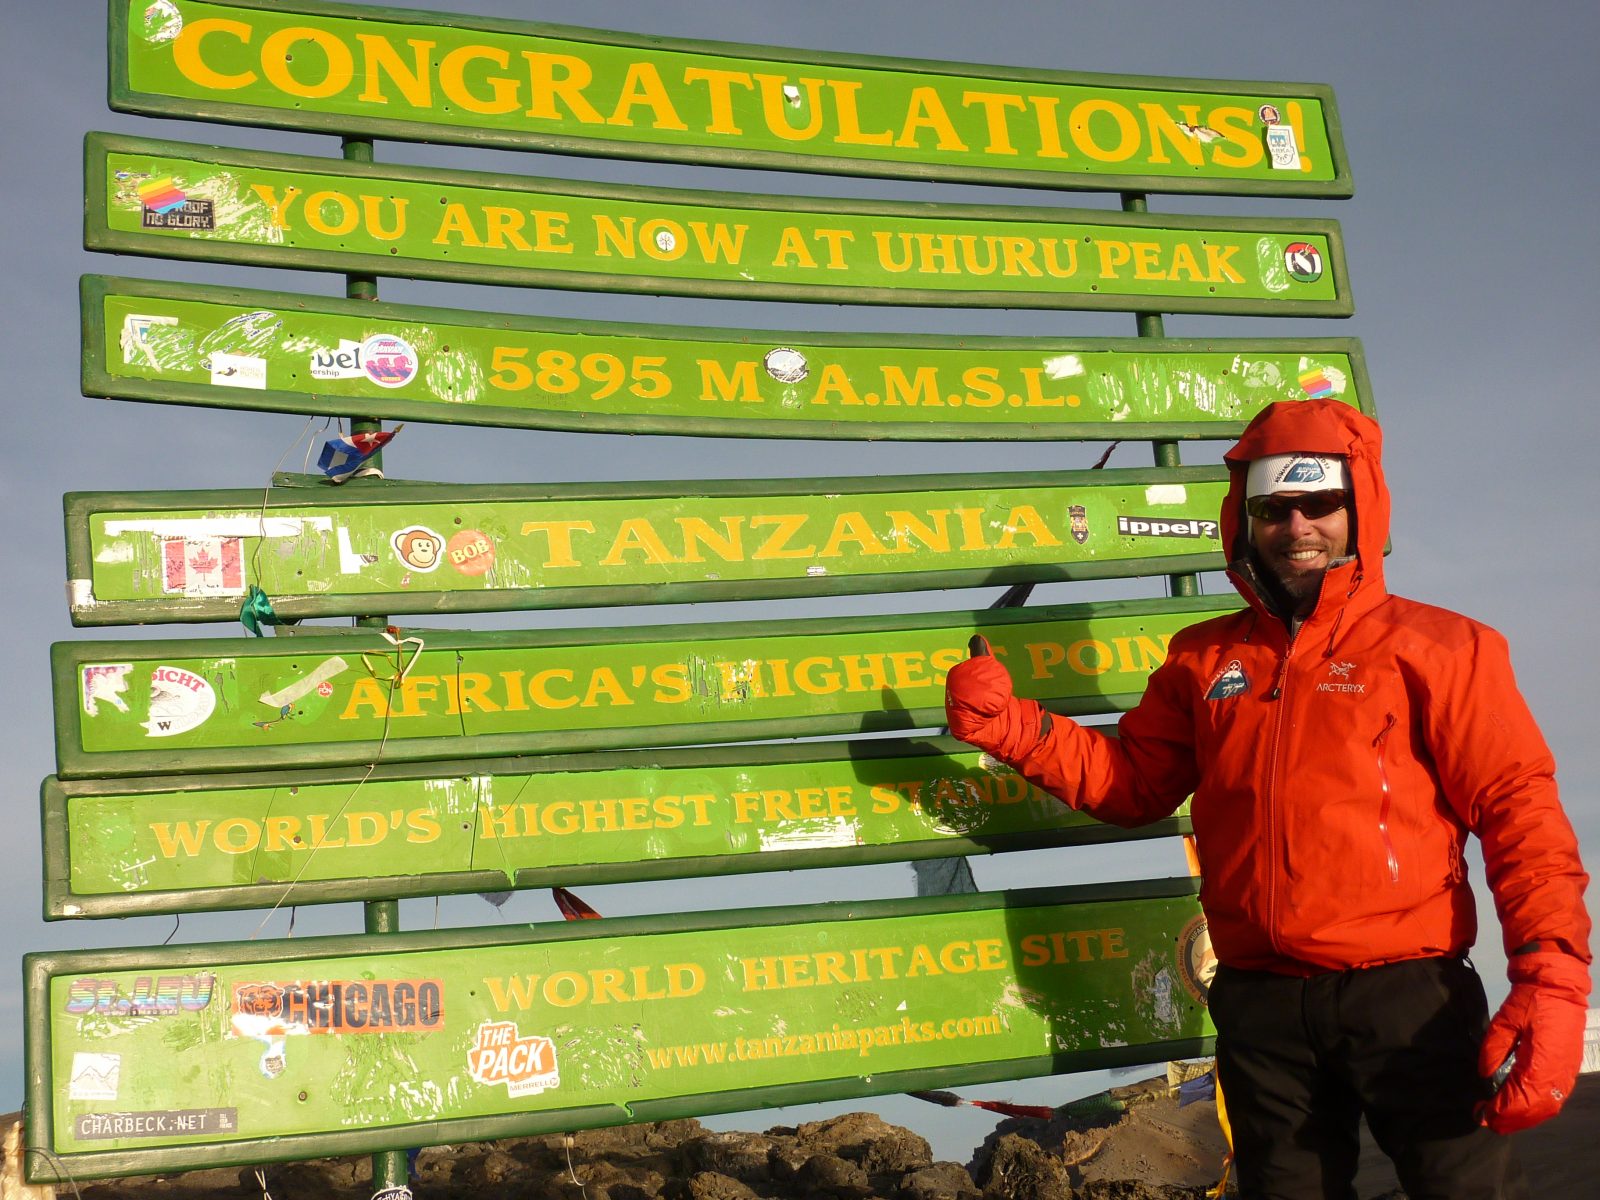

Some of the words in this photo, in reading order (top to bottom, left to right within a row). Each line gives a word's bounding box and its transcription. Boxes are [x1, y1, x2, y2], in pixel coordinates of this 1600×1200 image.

[172, 17, 1313, 173] CONGRATULATIONS!
[251, 183, 409, 241] YOU
[433, 203, 574, 253] ARE
[594, 214, 750, 266] NOW
[773, 226, 856, 270] AT
[873, 231, 1078, 279] UHURU
[1098, 239, 1247, 285] PEAK
[490, 346, 673, 400] 5895
[697, 358, 764, 402] M
[811, 363, 1081, 409] A.M.S.L.
[450, 539, 490, 564] BOB
[522, 504, 1063, 569] TANZANIA
[1119, 516, 1216, 536] ippel?
[339, 664, 692, 721] AFRICA'S
[716, 645, 1006, 701] HIGHES
[1026, 634, 1173, 679] POIN
[150, 808, 441, 858] WORLD'S
[480, 794, 716, 840] HIGHEST
[733, 785, 858, 824] FREE
[483, 964, 708, 1013] WORLD
[741, 938, 1008, 993] HERITAGE
[1020, 926, 1130, 967] SITE
[281, 981, 440, 1028] CHICAGO
[476, 1041, 547, 1078] PACK
[483, 1026, 513, 1047] THE
[648, 1013, 1001, 1070] www.tanzaniaparks.com
[81, 1114, 207, 1135] CHARBECK.NET
